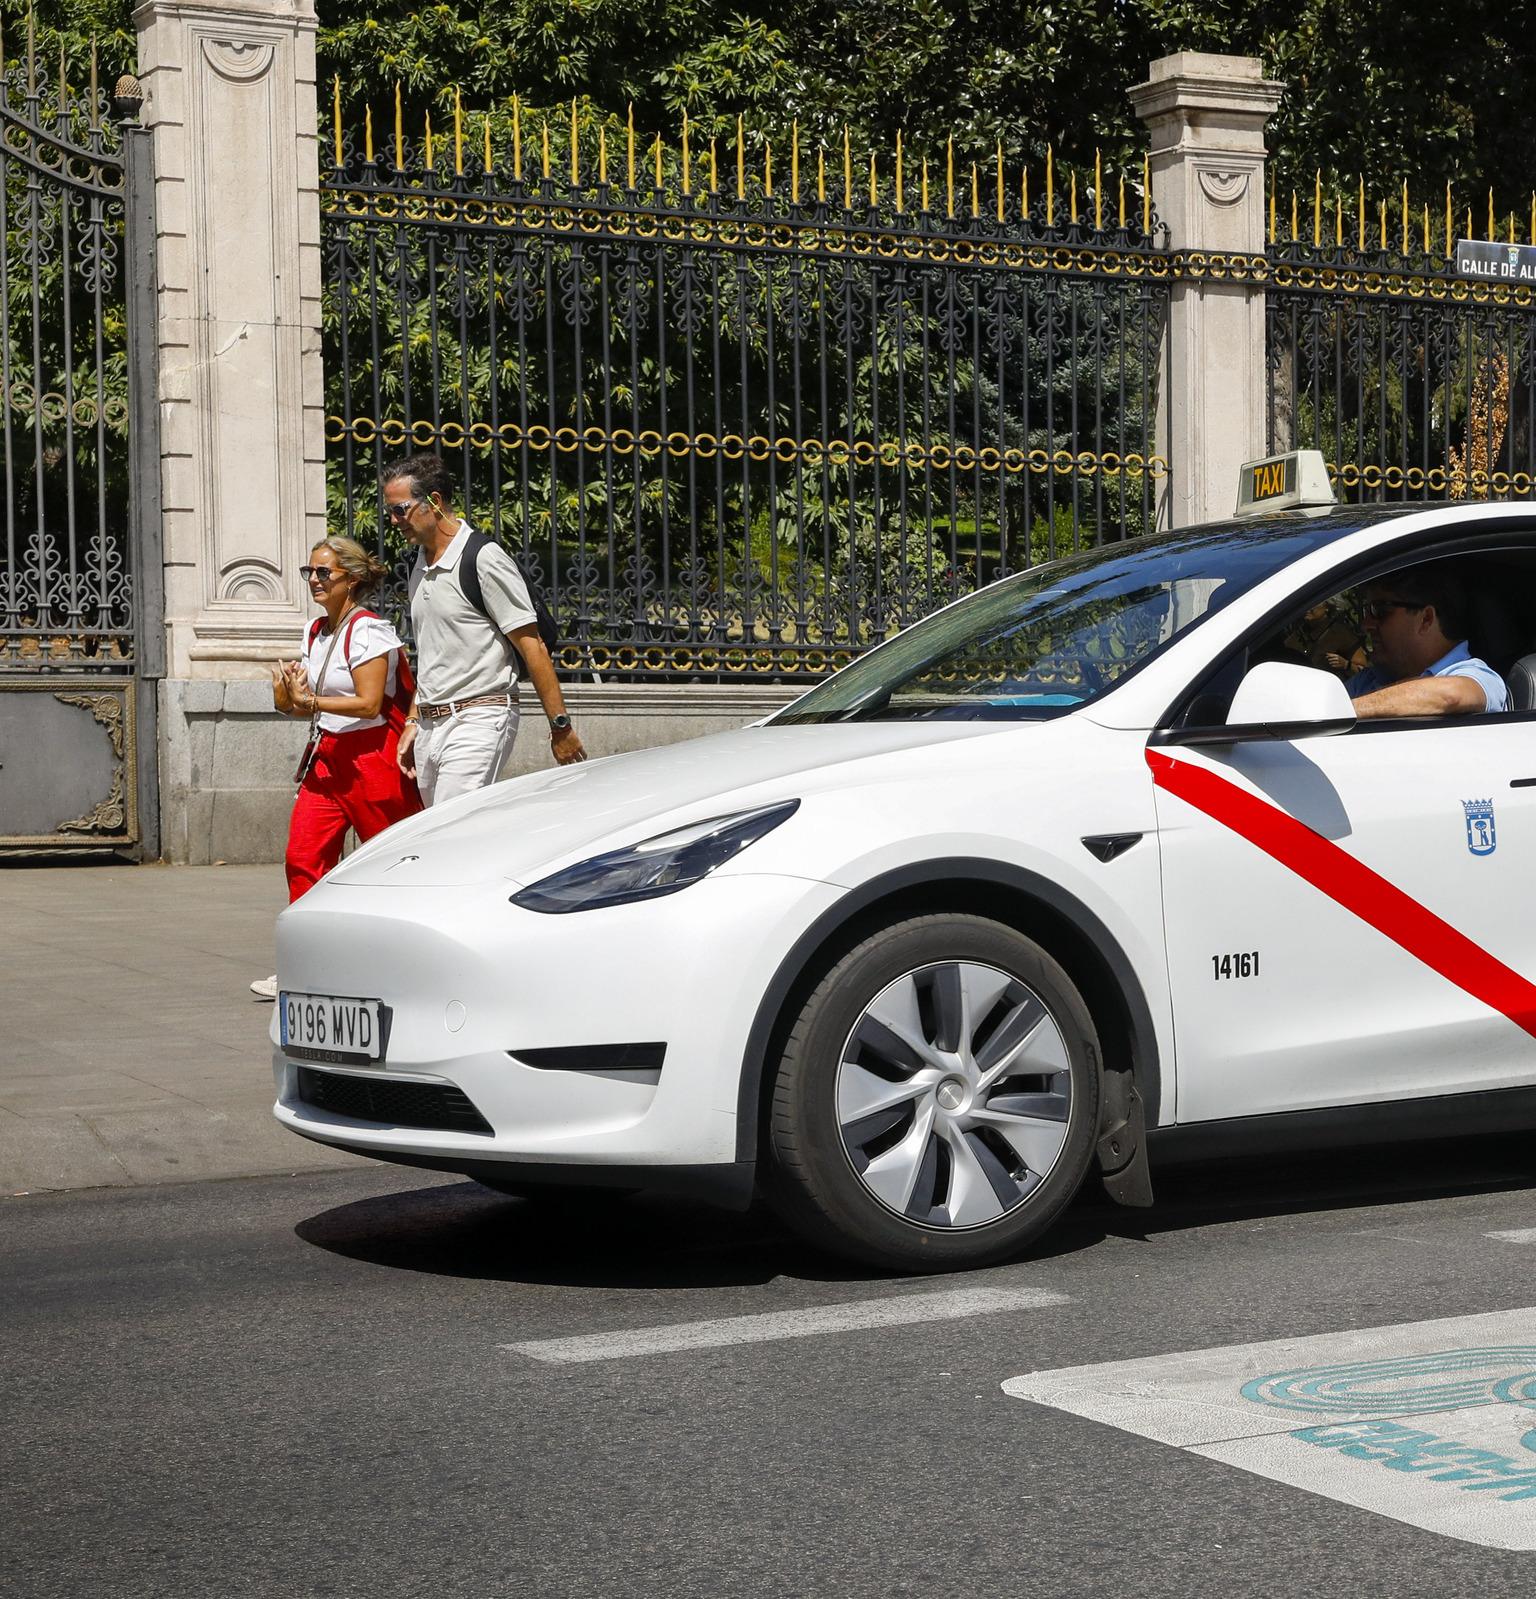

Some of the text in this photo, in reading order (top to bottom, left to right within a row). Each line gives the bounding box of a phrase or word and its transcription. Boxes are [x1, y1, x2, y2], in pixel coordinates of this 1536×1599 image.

[1461, 259, 1498, 276] CALLE
[1501, 263, 1516, 277] DE
[1254, 463, 1284, 498] TAXI
[1211, 951, 1259, 981] 14161
[287, 1001, 371, 1048] 9196 MVD
